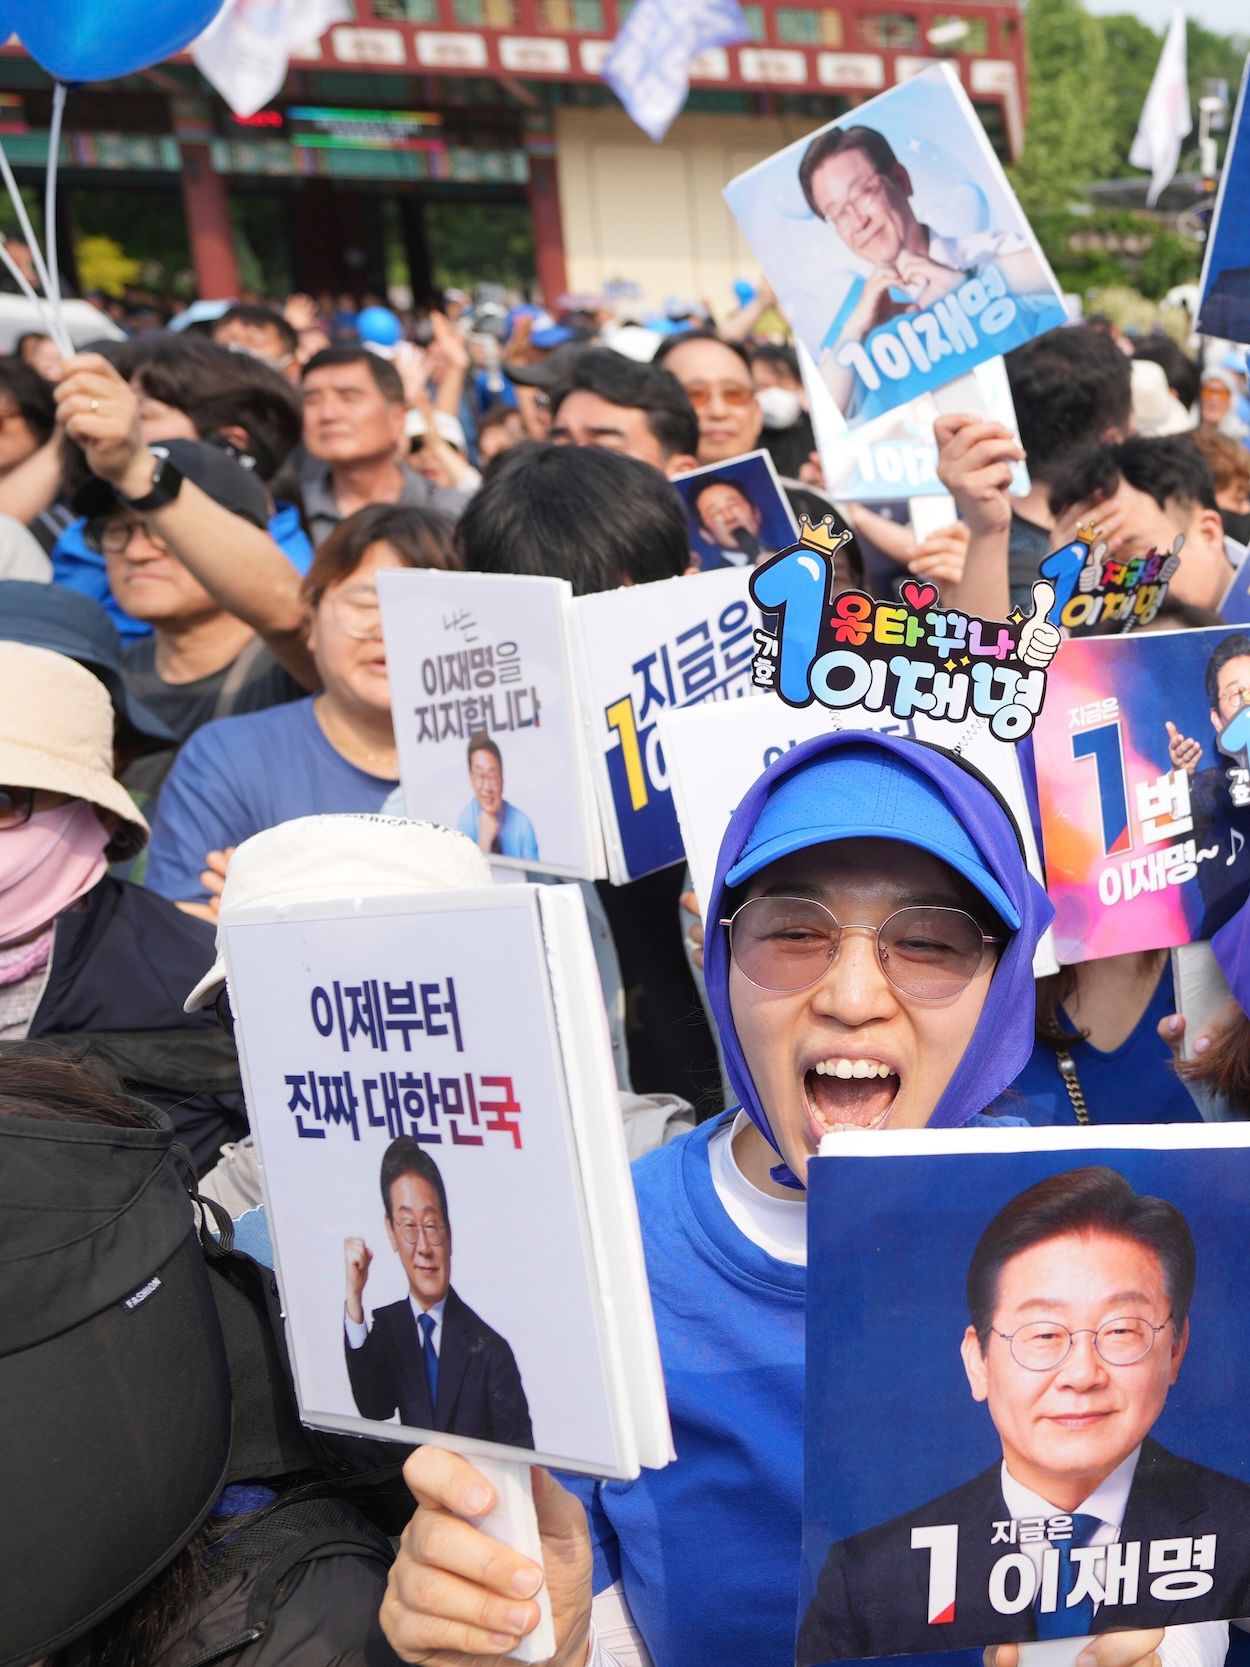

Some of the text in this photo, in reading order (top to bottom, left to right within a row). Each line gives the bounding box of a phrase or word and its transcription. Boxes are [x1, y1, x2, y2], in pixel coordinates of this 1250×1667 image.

[1040, 540, 1090, 627] 1
[443, 608, 479, 643] 나는
[753, 550, 828, 703] 1
[754, 631, 779, 686] 기호
[421, 640, 522, 697] 이재명을
[605, 693, 648, 812] 1
[632, 600, 755, 723] 지금은
[810, 650, 1044, 740] 이재명
[415, 686, 541, 743] 지지합니다
[1067, 697, 1120, 728] 지금은
[1229, 768, 1250, 806] 기호
[310, 976, 464, 1052] 이제부터
[285, 1070, 523, 1149] 진짜 대한민국
[126, 1277, 161, 1308] FASHION
[910, 1515, 1074, 1624] 1 지금은
[988, 1533, 1218, 1615] 이재명
